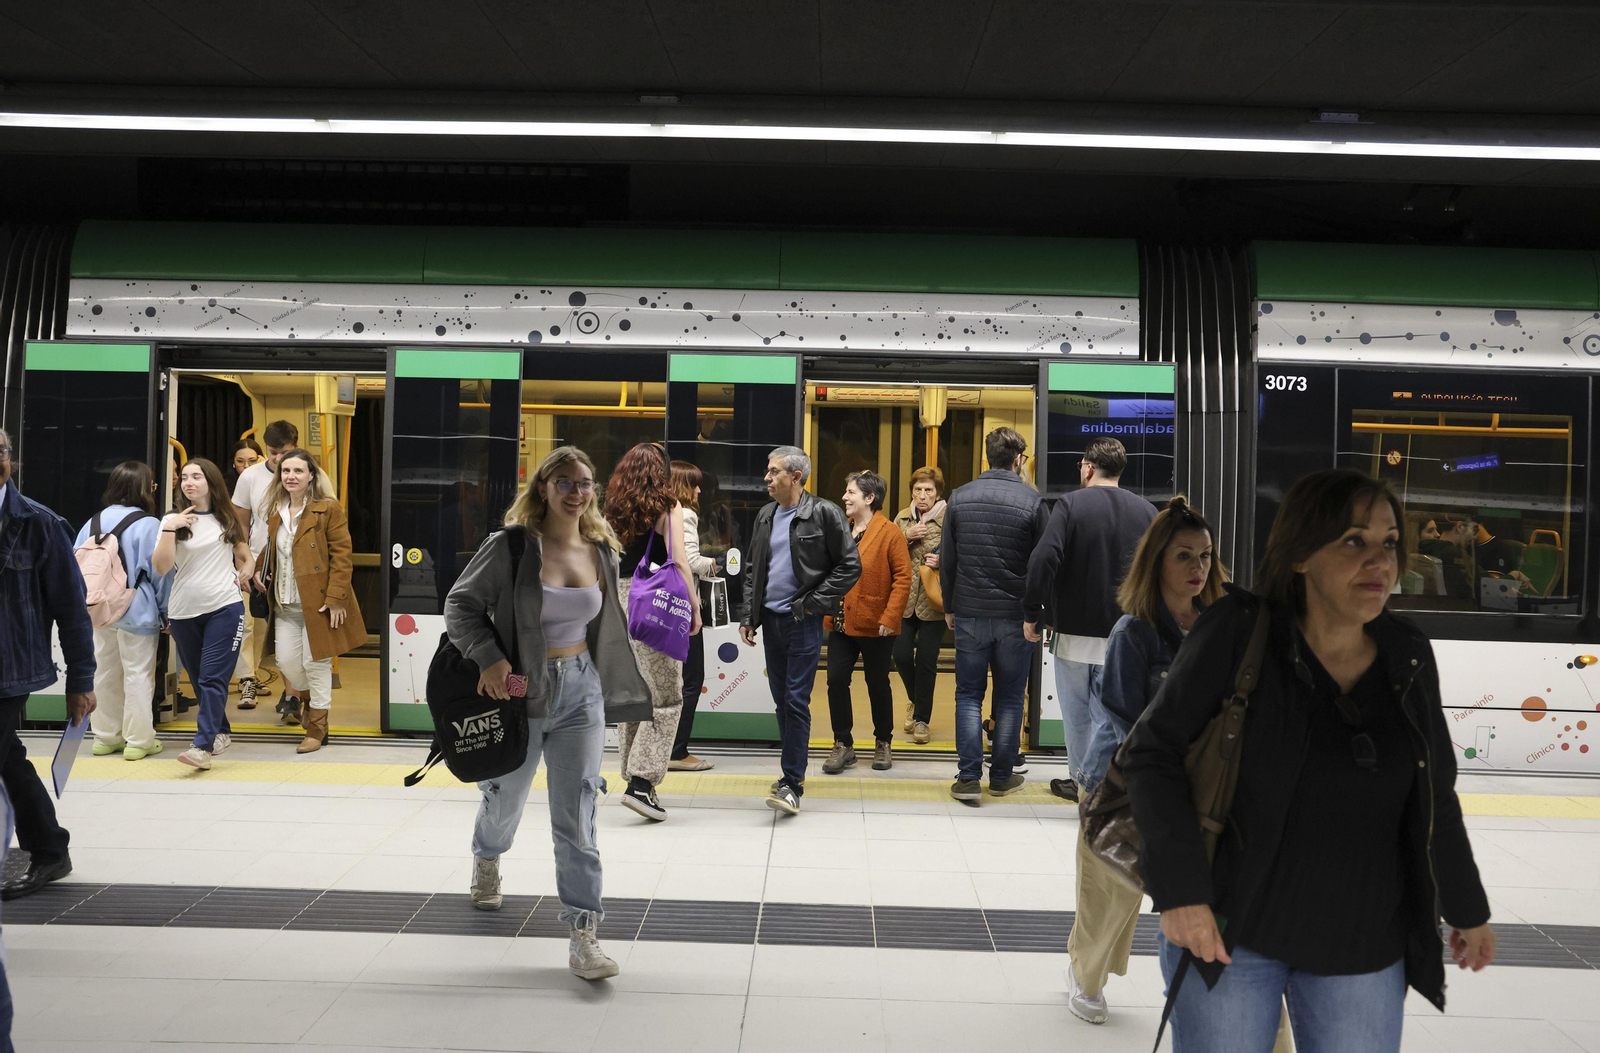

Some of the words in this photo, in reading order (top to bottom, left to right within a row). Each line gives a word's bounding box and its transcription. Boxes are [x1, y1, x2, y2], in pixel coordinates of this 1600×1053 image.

[193, 314, 223, 332] Universidad
[272, 310, 290, 322] Ciudad
[1101, 327, 1126, 341] Paraninfo
[1265, 374, 1308, 391] 3073
[652, 598, 668, 611] UNA
[708, 669, 749, 710] Atarazanas
[451, 708, 501, 738] VANS
[478, 734, 490, 742] Wall
[455, 746, 473, 754] Since
[1525, 743, 1556, 764] Clínico
